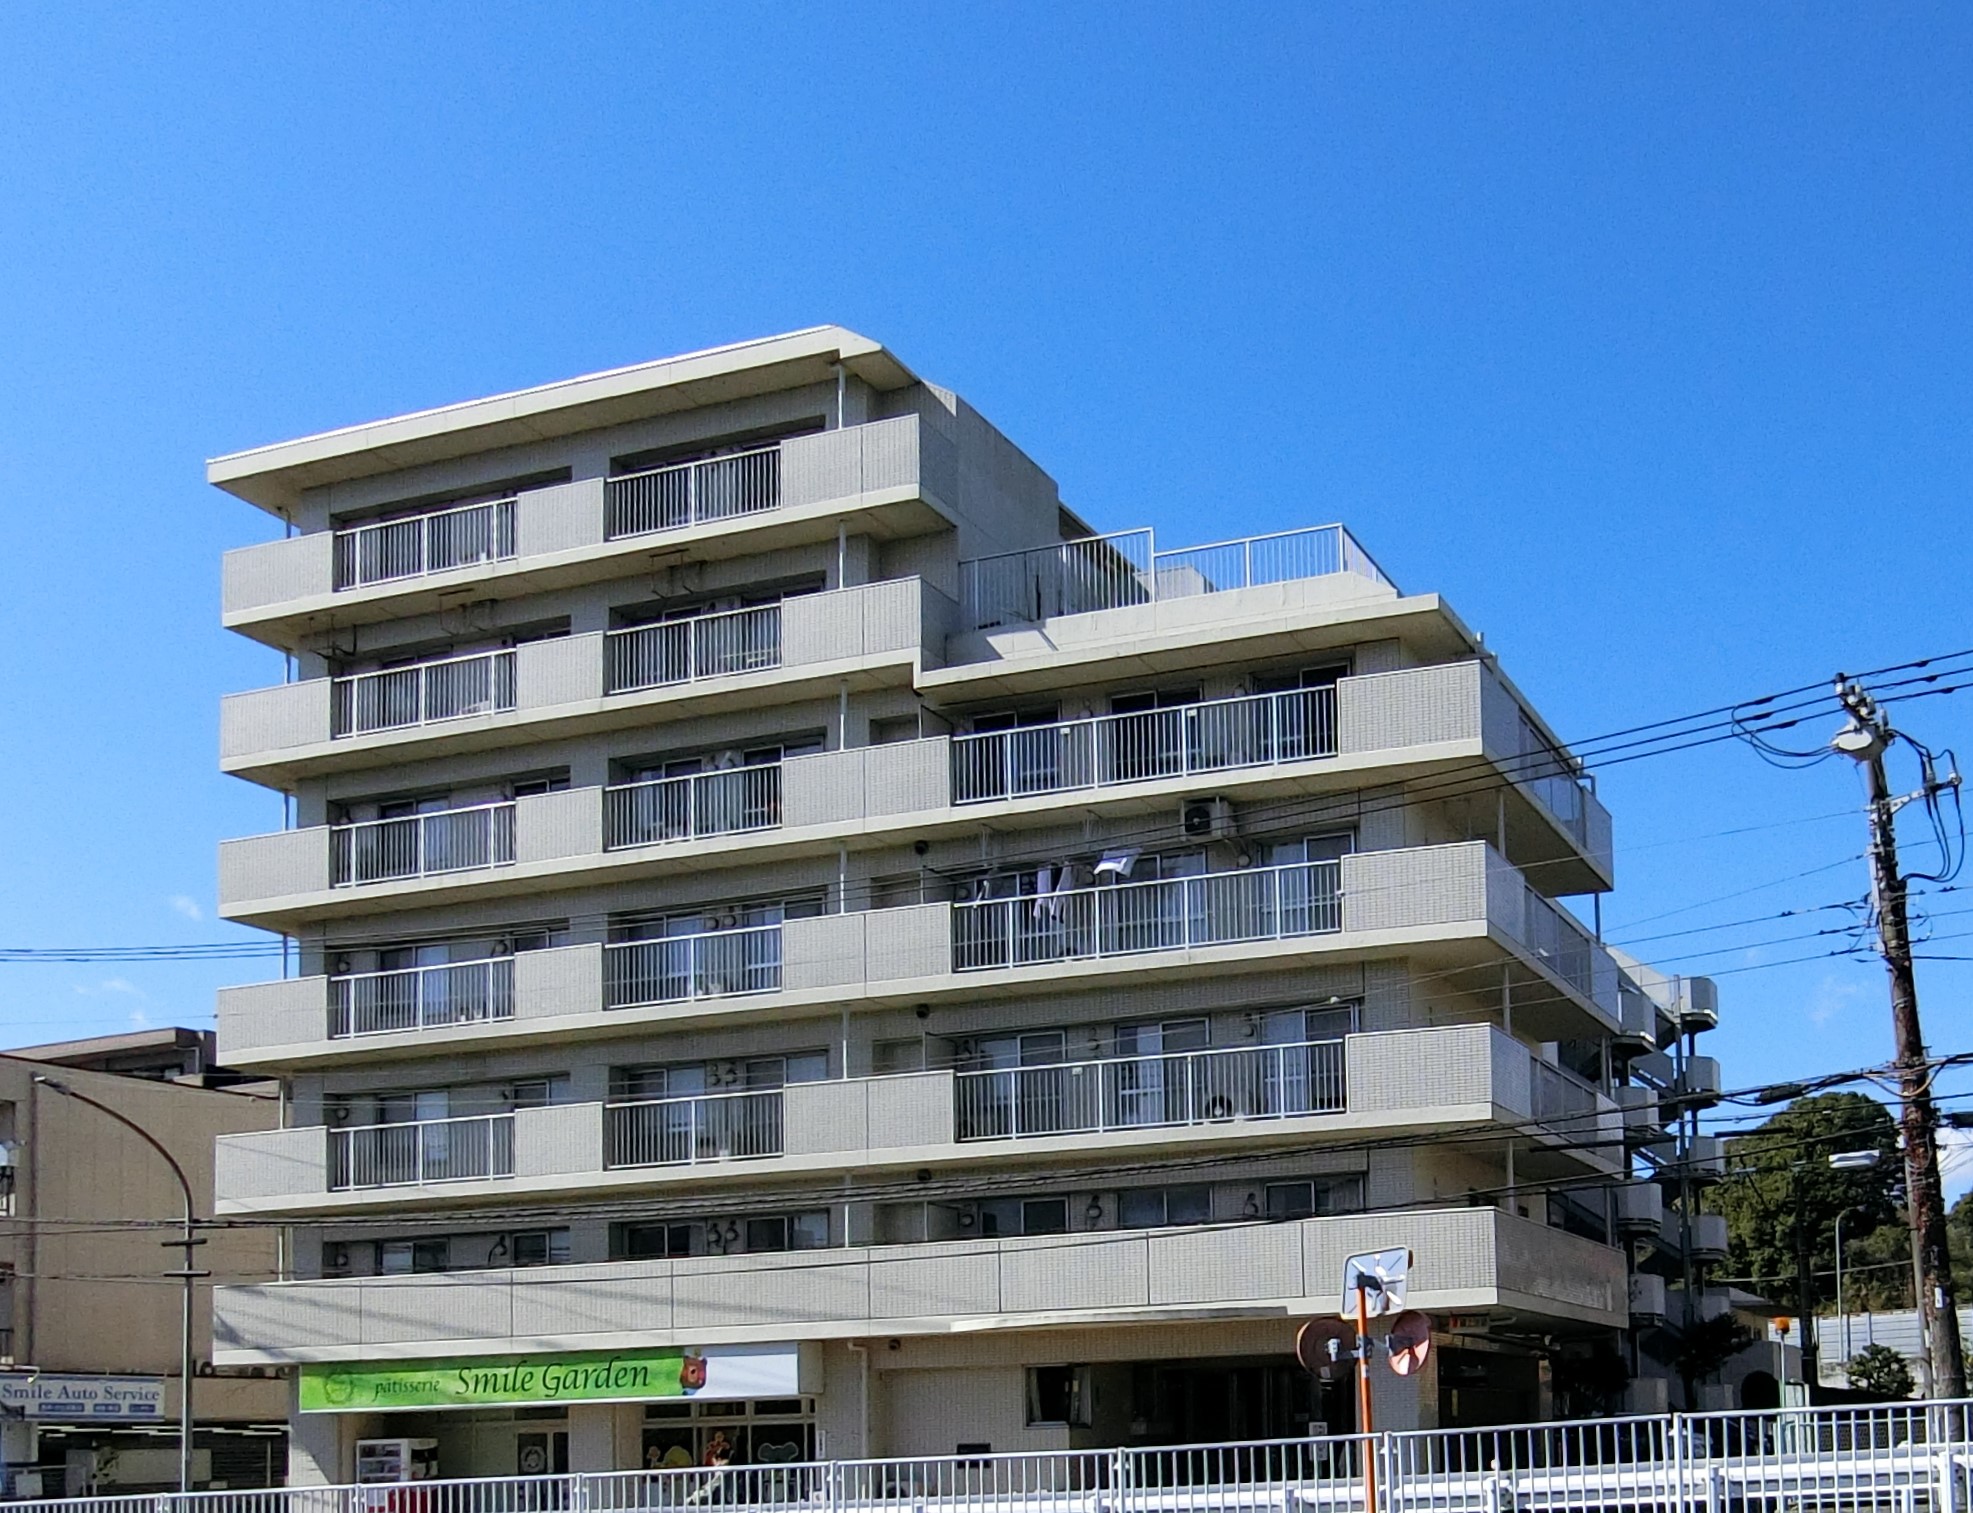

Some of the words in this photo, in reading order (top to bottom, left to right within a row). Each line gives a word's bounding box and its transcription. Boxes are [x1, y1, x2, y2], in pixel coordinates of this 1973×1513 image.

[455, 1360, 534, 1395] Smile
[542, 1356, 649, 1397] Garden
[2, 1384, 51, 1399] Smile
[57, 1385, 98, 1399] Auto
[103, 1386, 160, 1401] Service
